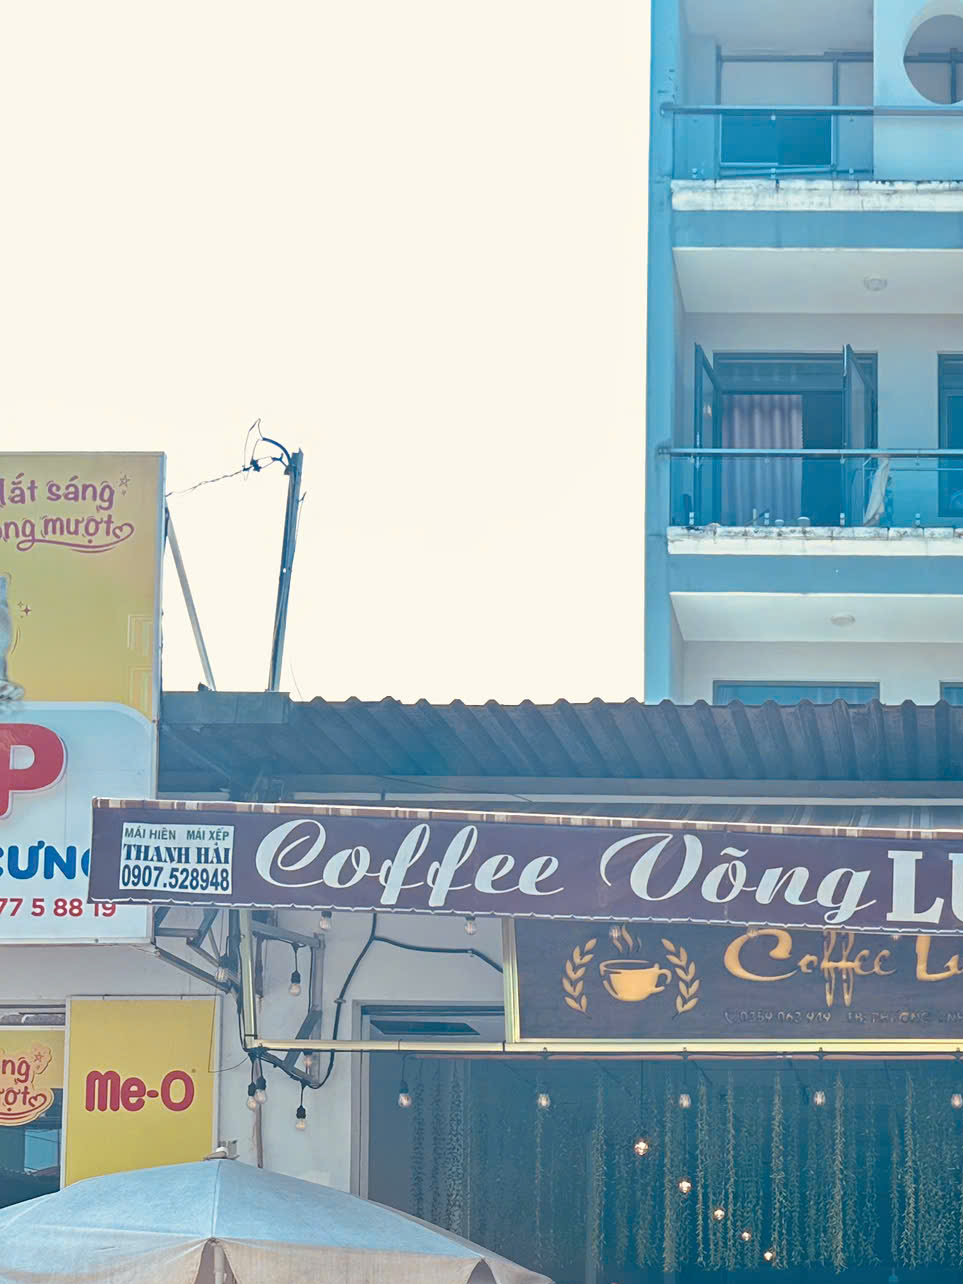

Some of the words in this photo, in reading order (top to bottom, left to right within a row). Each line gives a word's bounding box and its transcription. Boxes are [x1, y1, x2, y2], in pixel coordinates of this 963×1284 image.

[47, 475, 115, 511] sáng
[0, 519, 36, 551] ng
[43, 514, 115, 545] mượt
[124, 826, 146, 839] MÁI
[149, 827, 176, 841] HIÊN
[186, 828, 206, 841] MÁI
[209, 827, 230, 841] XẾP
[0, 841, 90, 880] ƯN
[123, 844, 191, 864] THANH
[196, 842, 231, 865] HẢI
[255, 819, 565, 907] Coffee
[600, 832, 877, 924] Võng
[121, 864, 230, 892] 0907.528948
[31, 898, 45, 917] 5
[53, 898, 83, 917] 88
[723, 928, 897, 1008] Coffee
[0, 1057, 31, 1084] ng
[85, 1070, 195, 1112] Me-O
